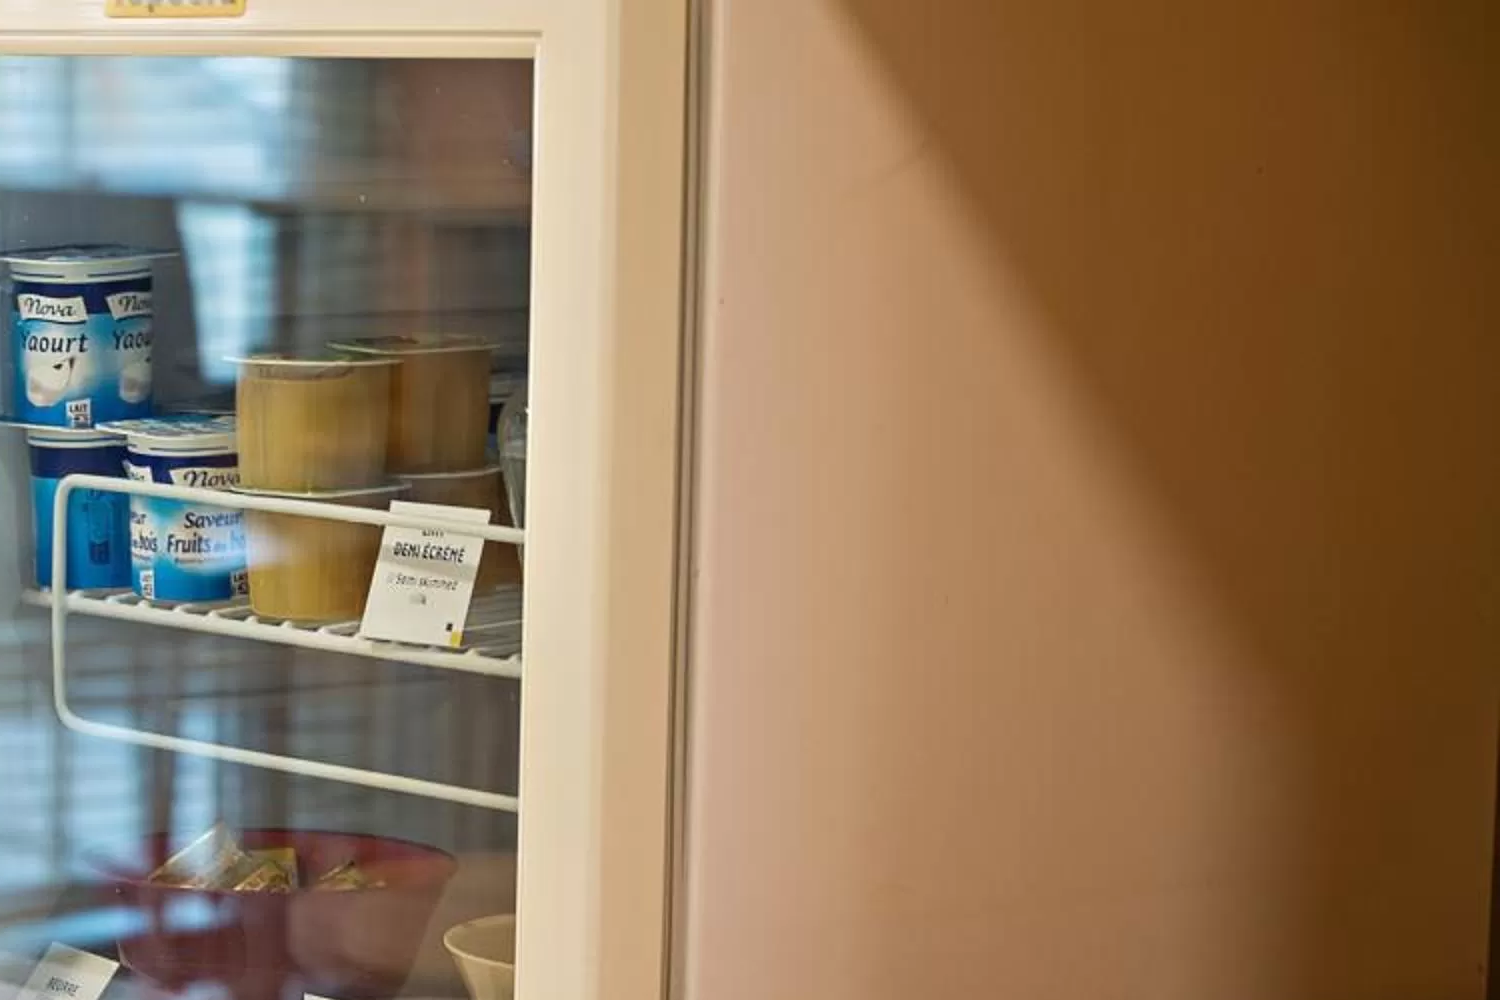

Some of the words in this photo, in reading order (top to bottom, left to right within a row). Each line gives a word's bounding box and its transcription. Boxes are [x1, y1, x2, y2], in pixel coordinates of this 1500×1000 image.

[24, 297, 75, 316] Nova
[20, 331, 89, 353] Yaourt
[183, 511, 244, 529] Saveur
[167, 532, 211, 553] Fruits
[393, 541, 421, 559] DEMI
